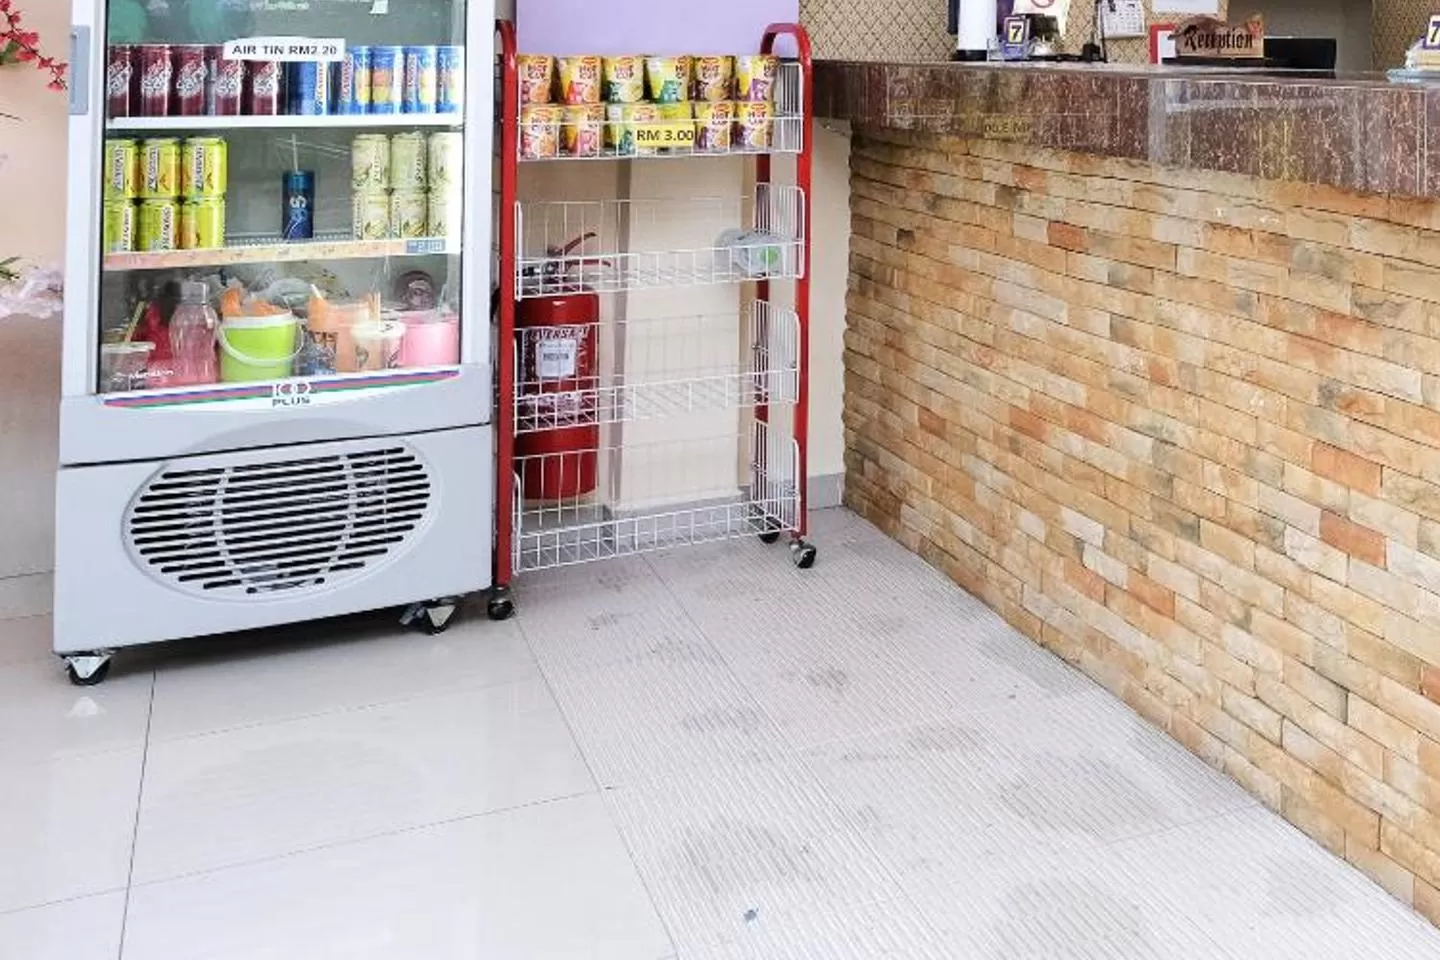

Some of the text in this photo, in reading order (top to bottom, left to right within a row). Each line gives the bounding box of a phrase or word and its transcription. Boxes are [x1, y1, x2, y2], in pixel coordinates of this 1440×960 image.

[1011, 24, 1022, 41] 7
[1184, 24, 1253, 53] Reception
[232, 45, 257, 55] AIR
[262, 45, 284, 55] TIN
[636, 129, 694, 142] RM 3.00
